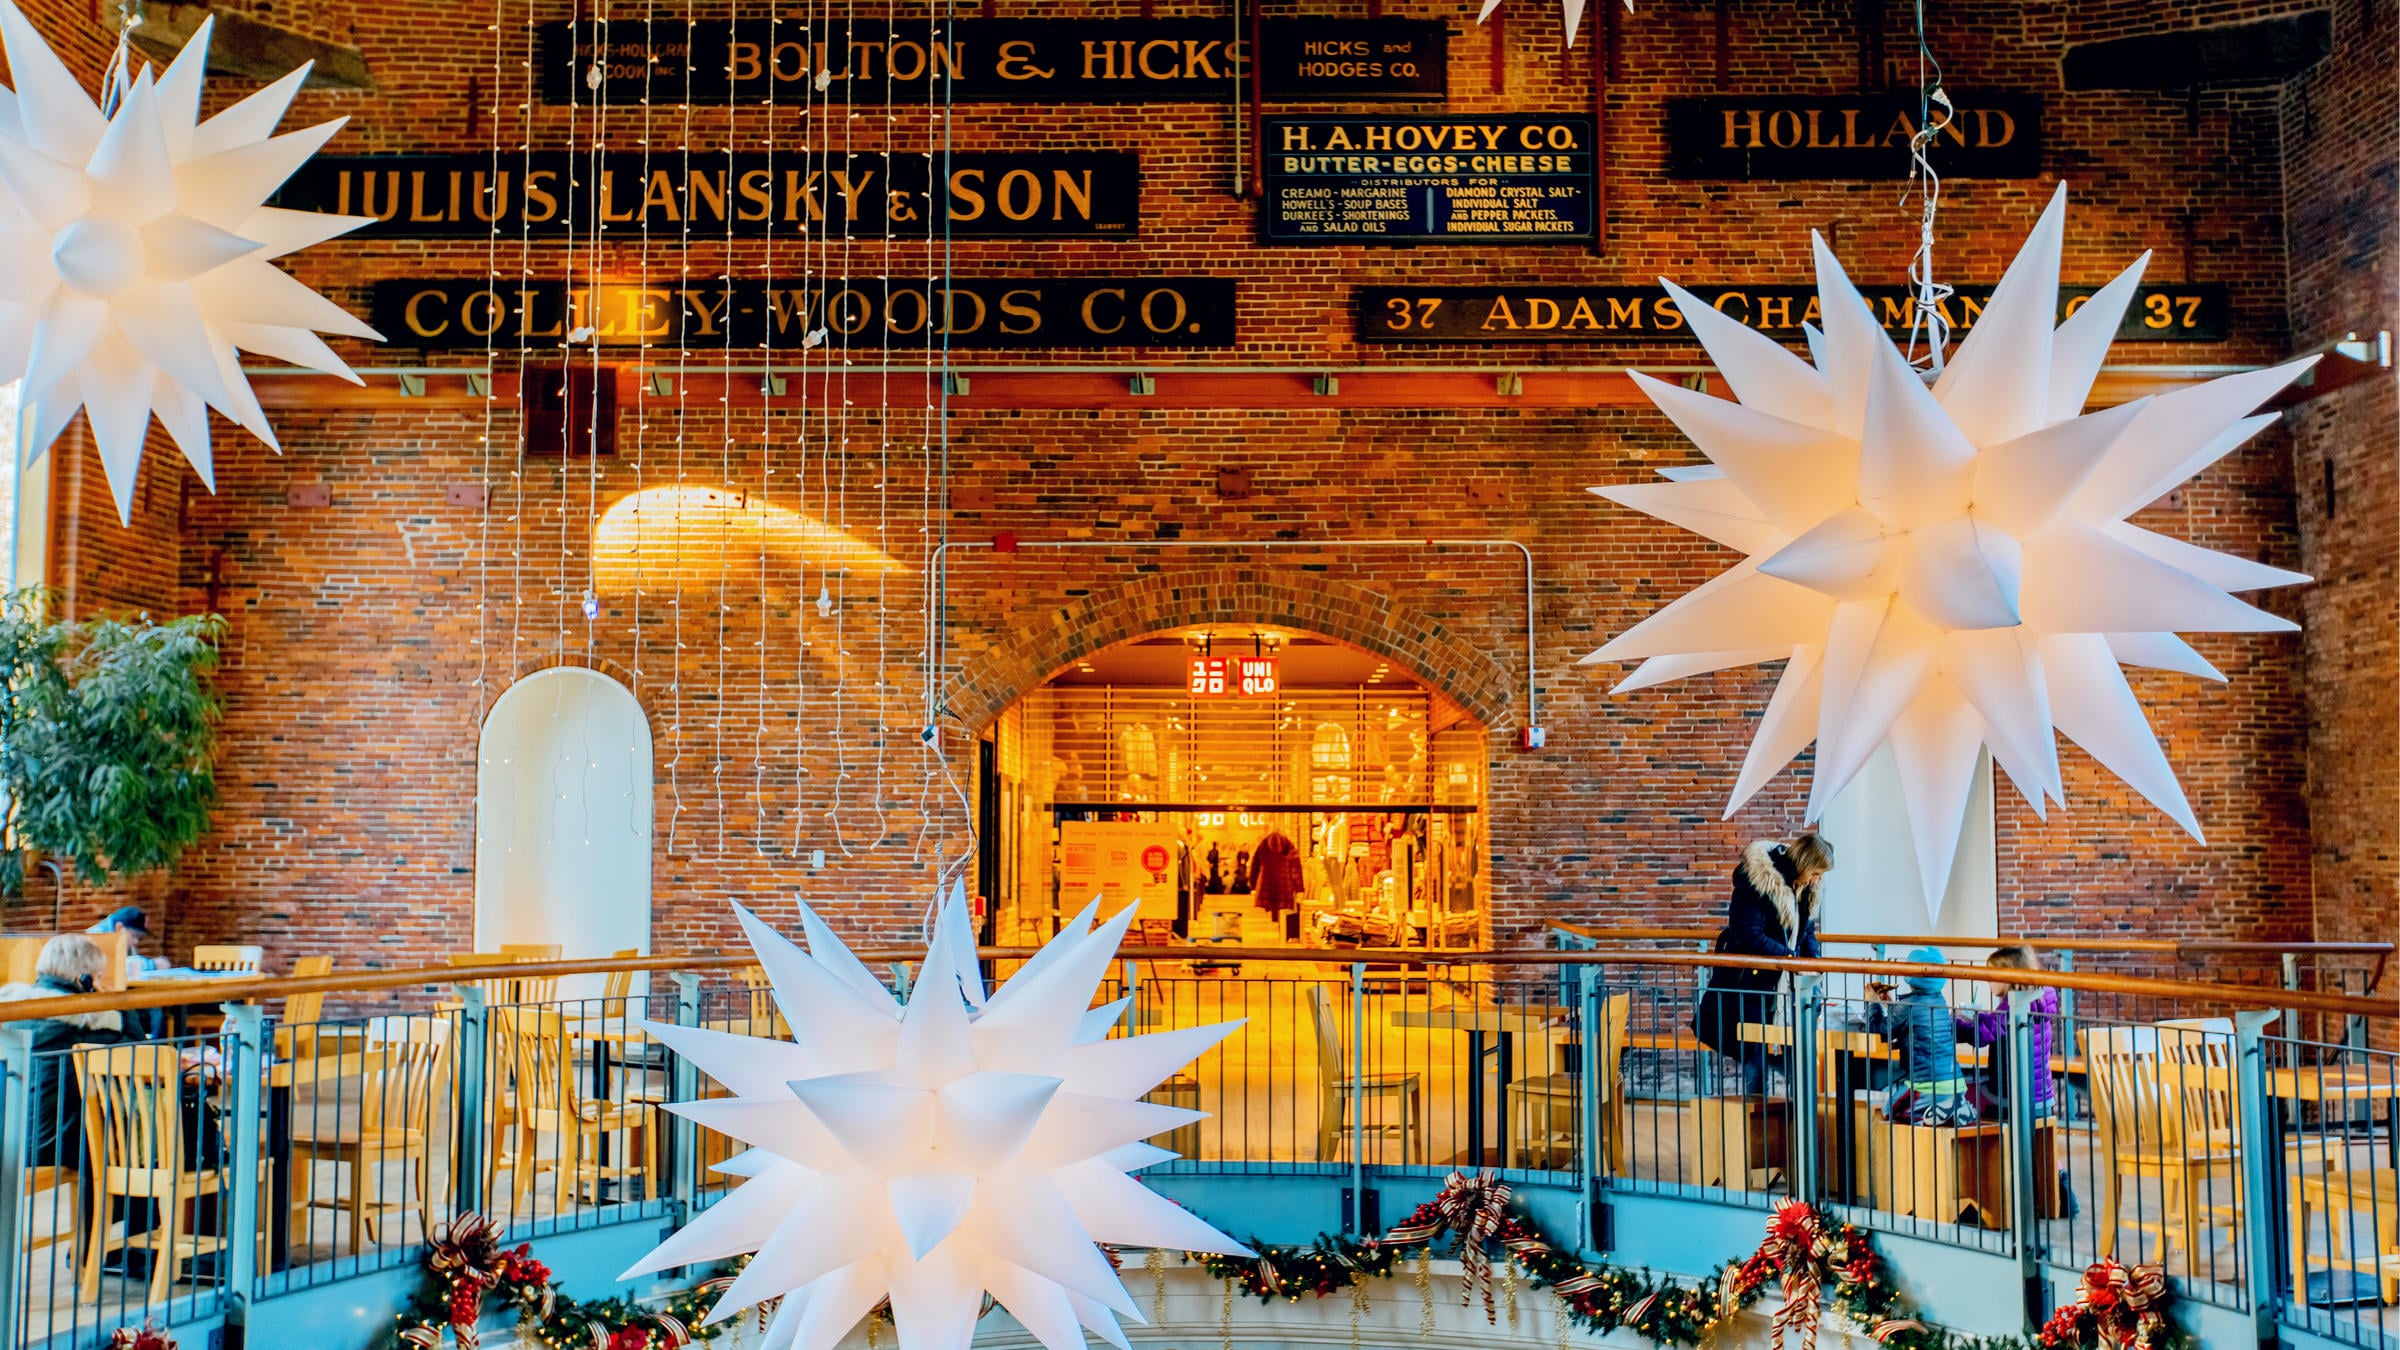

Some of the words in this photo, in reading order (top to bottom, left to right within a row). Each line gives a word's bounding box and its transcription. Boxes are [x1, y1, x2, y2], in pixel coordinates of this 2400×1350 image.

[1305, 41, 1370, 56] HICKS
[1383, 41, 1411, 54] and
[725, 41, 966, 81] BOLTON
[996, 40, 1055, 80] &
[1081, 40, 1251, 79] HICKS
[605, 64, 647, 79] COOK
[1299, 62, 1383, 77] HODGES
[1390, 62, 1420, 77] CO.
[1720, 110, 2015, 149] HOLLAND
[1519, 126, 1578, 149] CO.
[1468, 178, 1498, 186] FOR
[318, 170, 558, 221] JULIUS
[603, 170, 875, 221] LANSKY
[889, 190, 918, 221] &
[947, 169, 1093, 221] SON
[1446, 187, 1496, 198] DIAMOND
[1500, 187, 1545, 198] CRYSTAL
[1375, 200, 1408, 209] BASES
[1452, 198, 1509, 208] INDIVIDUAL
[1513, 198, 1538, 209] SALT
[1451, 212, 1468, 220] AND
[1471, 209, 1509, 220] PEPPER
[1300, 224, 1319, 232] AND
[1323, 222, 1358, 232] SALAD
[1362, 222, 1386, 232] OILS
[1447, 221, 1500, 232] INDIVIDUAL
[1503, 221, 1533, 232] SUGAR
[1535, 221, 1574, 232] PACKETS
[1081, 288, 1201, 335] CO.
[1386, 298, 1443, 330] 37
[1480, 295, 1684, 331] ADAMS
[2144, 293, 2203, 329] 37
[1242, 661, 1272, 677] UNI
[1242, 678, 1275, 696] QLO
